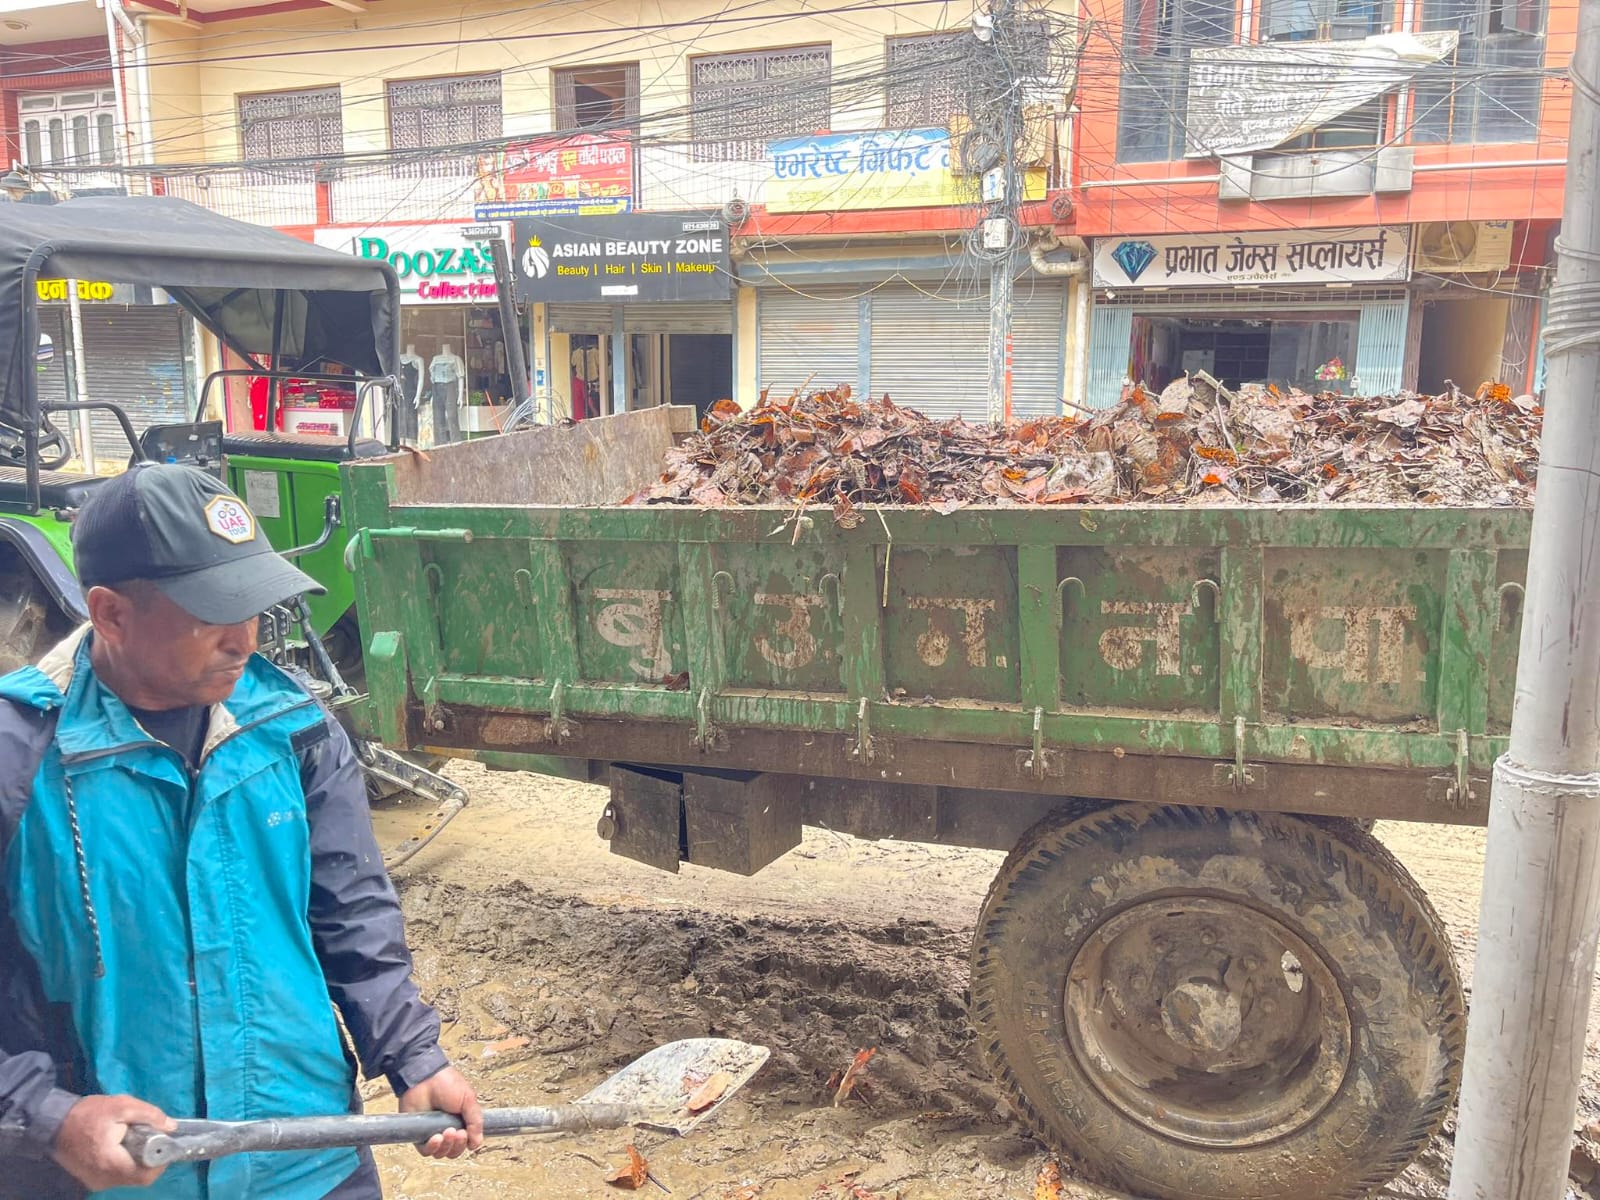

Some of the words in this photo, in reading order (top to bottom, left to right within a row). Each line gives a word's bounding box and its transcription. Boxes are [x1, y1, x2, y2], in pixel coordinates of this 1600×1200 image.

[552, 243, 601, 258] ASIAN
[605, 240, 671, 256] BEAUTY
[675, 238, 723, 254] ZONE
[1165, 244, 1220, 278] प्रभात
[1225, 236, 1280, 273] जेम्स
[1286, 230, 1387, 273] सप्लायर्स
[557, 264, 590, 277] Beauty
[605, 263, 626, 275] Hair
[641, 262, 663, 273] Skin
[675, 262, 716, 275] Makeup
[218, 515, 247, 530] UAE
